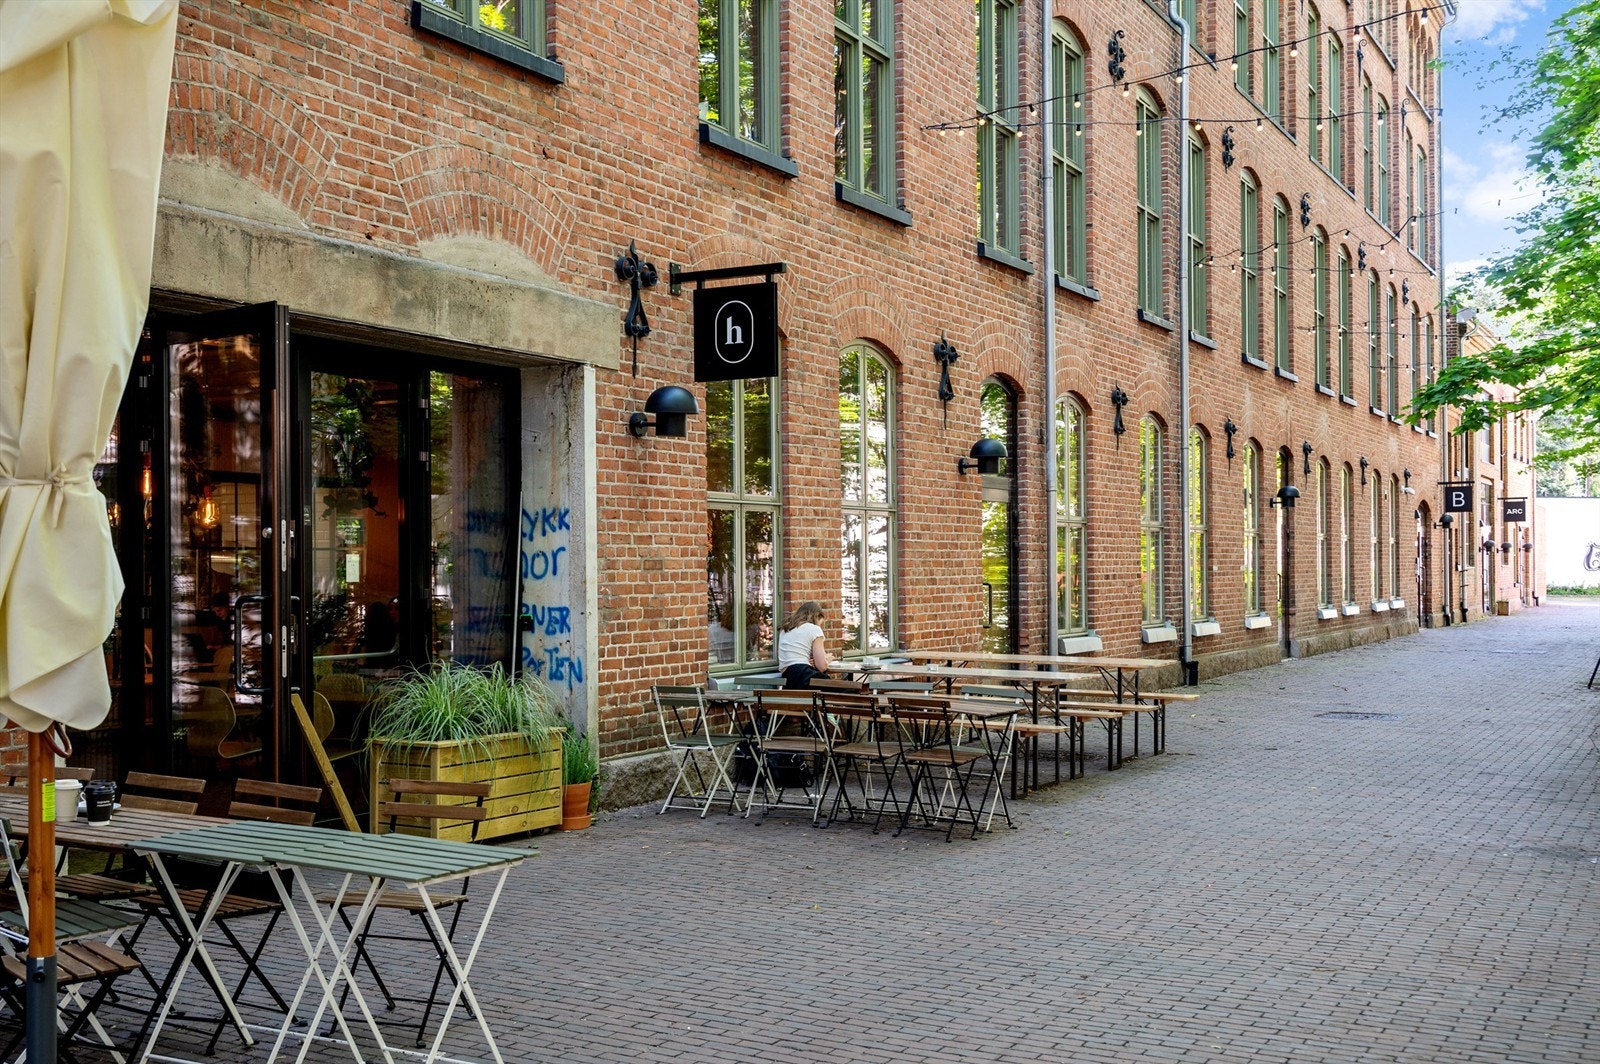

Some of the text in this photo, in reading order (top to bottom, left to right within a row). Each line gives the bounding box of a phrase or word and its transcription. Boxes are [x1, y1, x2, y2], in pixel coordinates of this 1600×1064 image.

[724, 315, 744, 345] h
[1452, 491, 1465, 507] B
[521, 507, 570, 541] YKK
